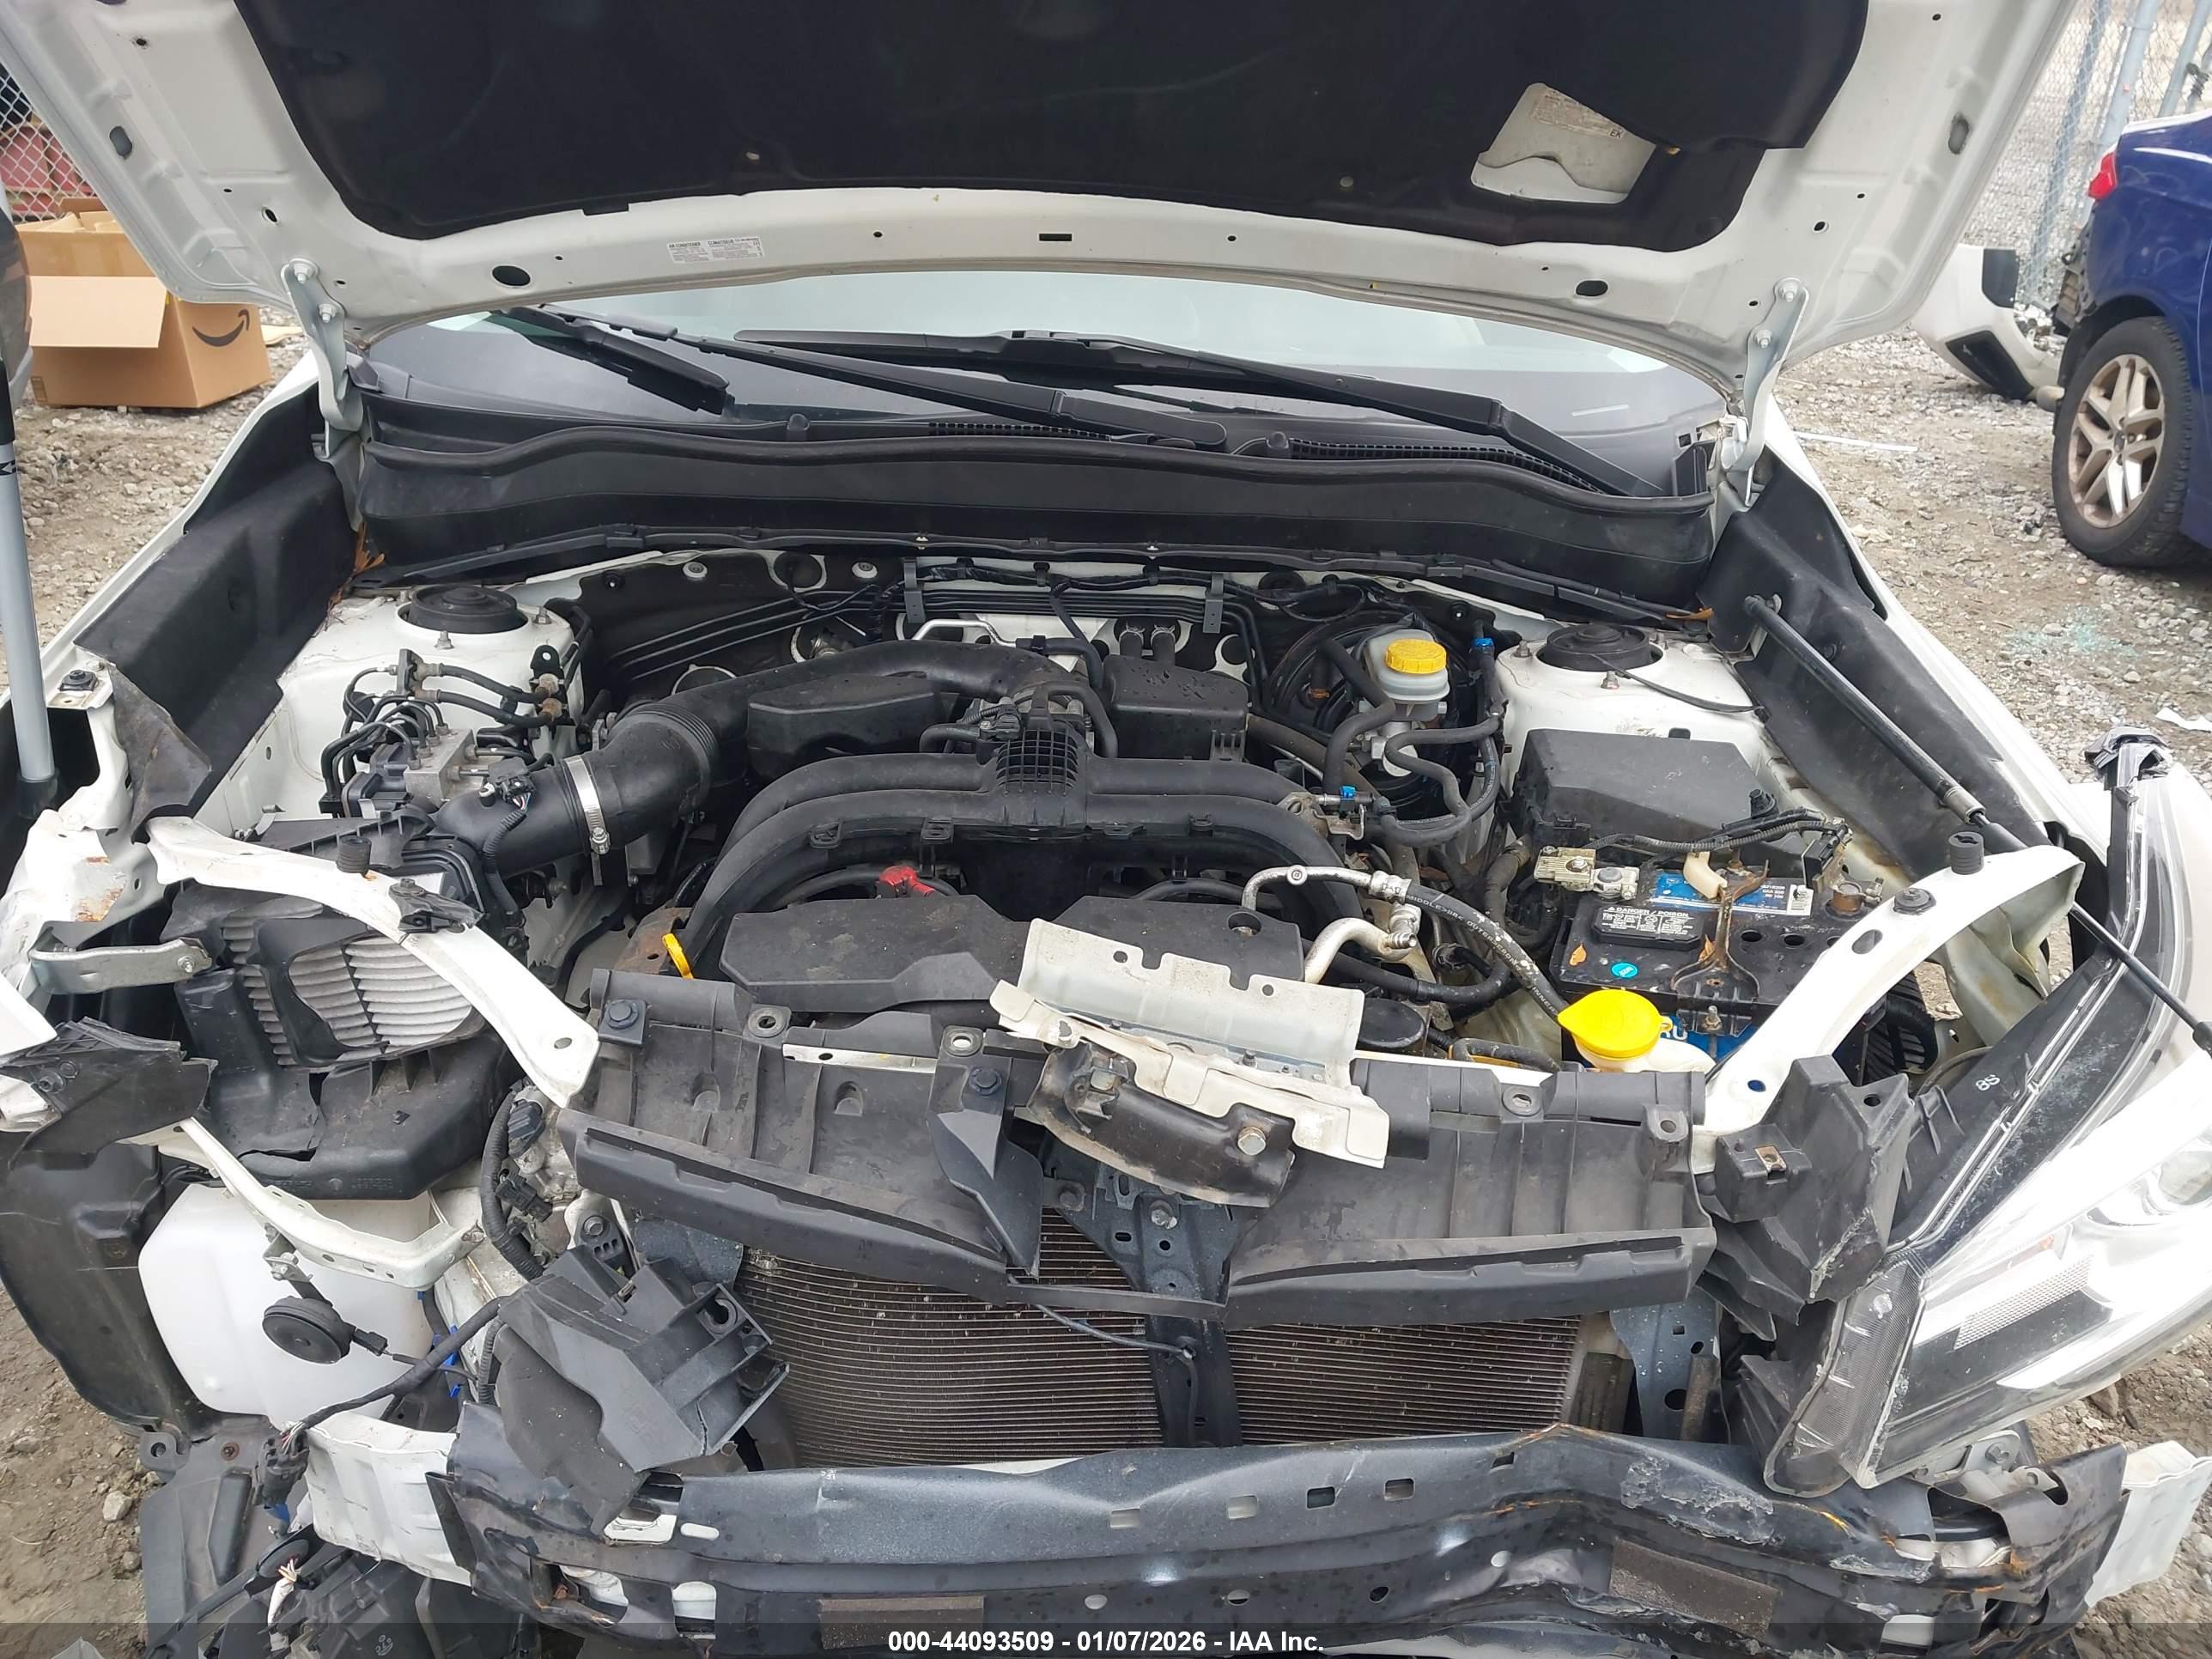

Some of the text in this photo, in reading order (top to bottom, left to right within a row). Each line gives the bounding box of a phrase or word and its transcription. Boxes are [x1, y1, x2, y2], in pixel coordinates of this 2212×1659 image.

[1610, 129, 1623, 138] EK
[1616, 906, 1650, 915] DANGER
[1657, 910, 1689, 919] POISON
